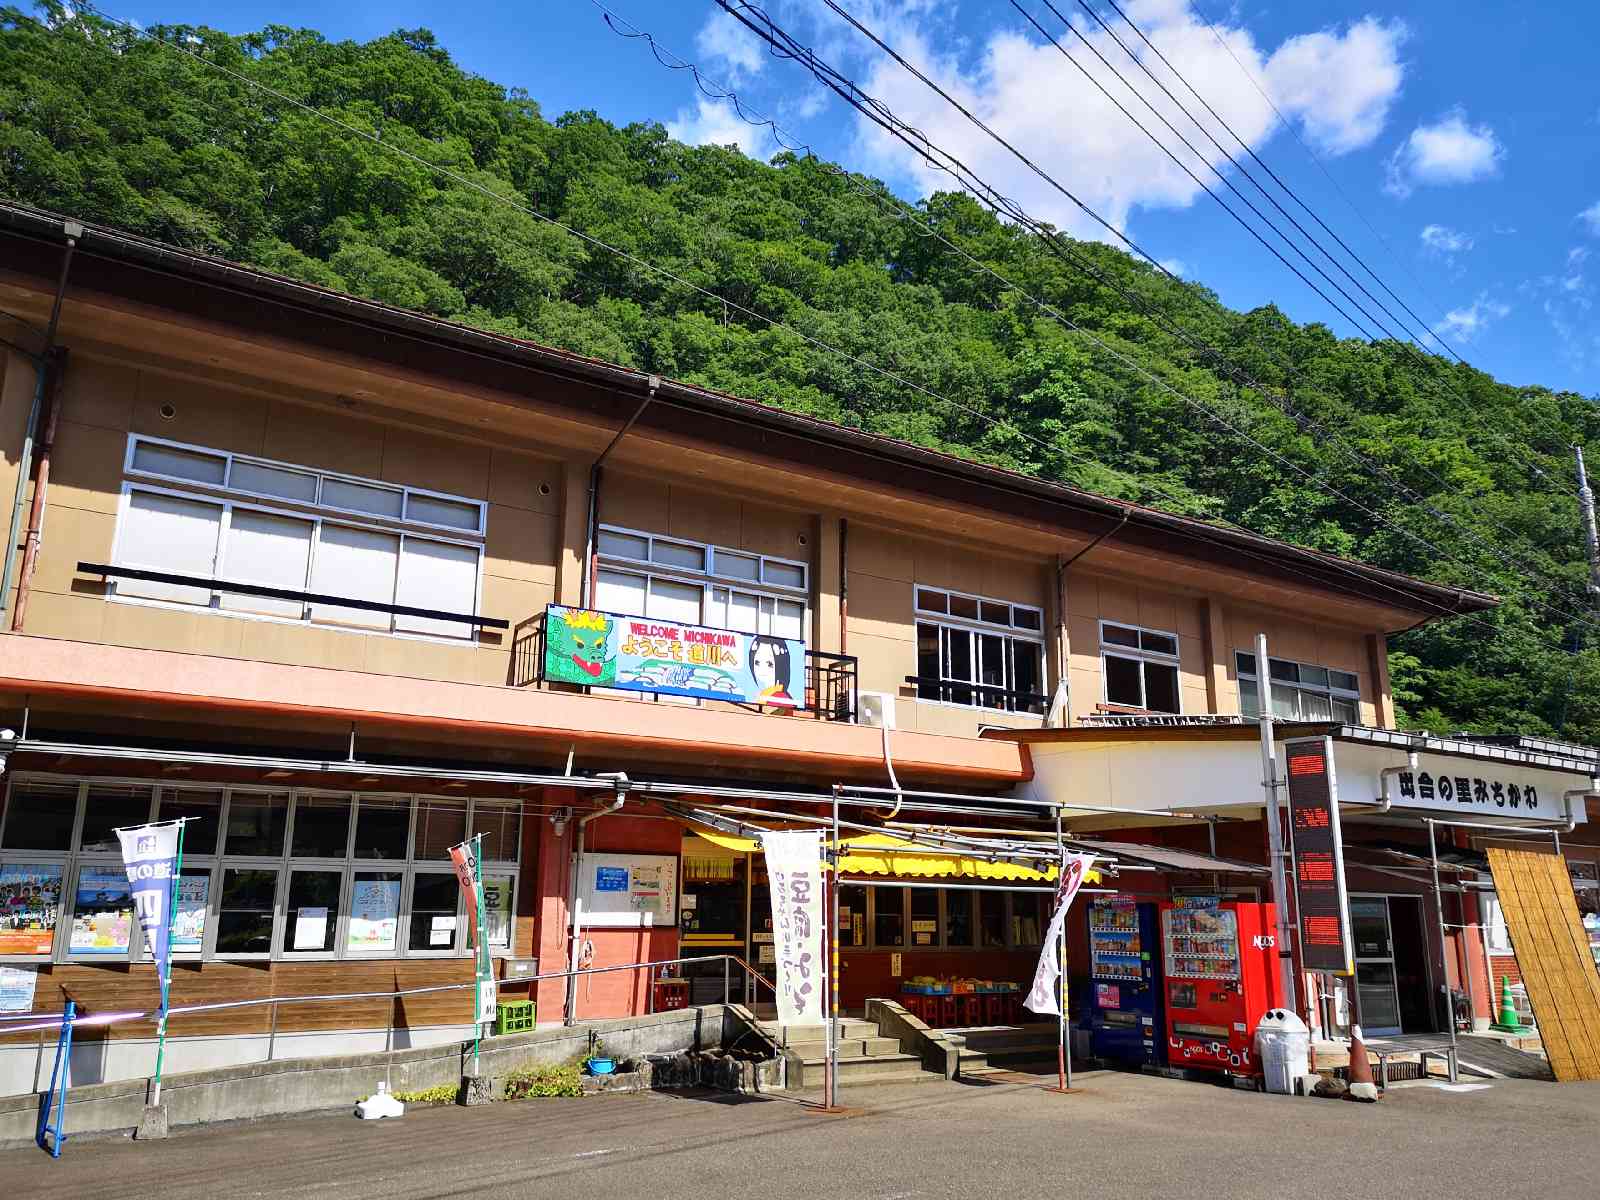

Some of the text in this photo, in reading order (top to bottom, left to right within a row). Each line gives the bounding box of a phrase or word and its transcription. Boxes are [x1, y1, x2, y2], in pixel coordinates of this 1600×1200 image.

[630, 622, 736, 647] WELCOME MICHIKAWA
[621, 634, 738, 666] ようこそ 道川へ
